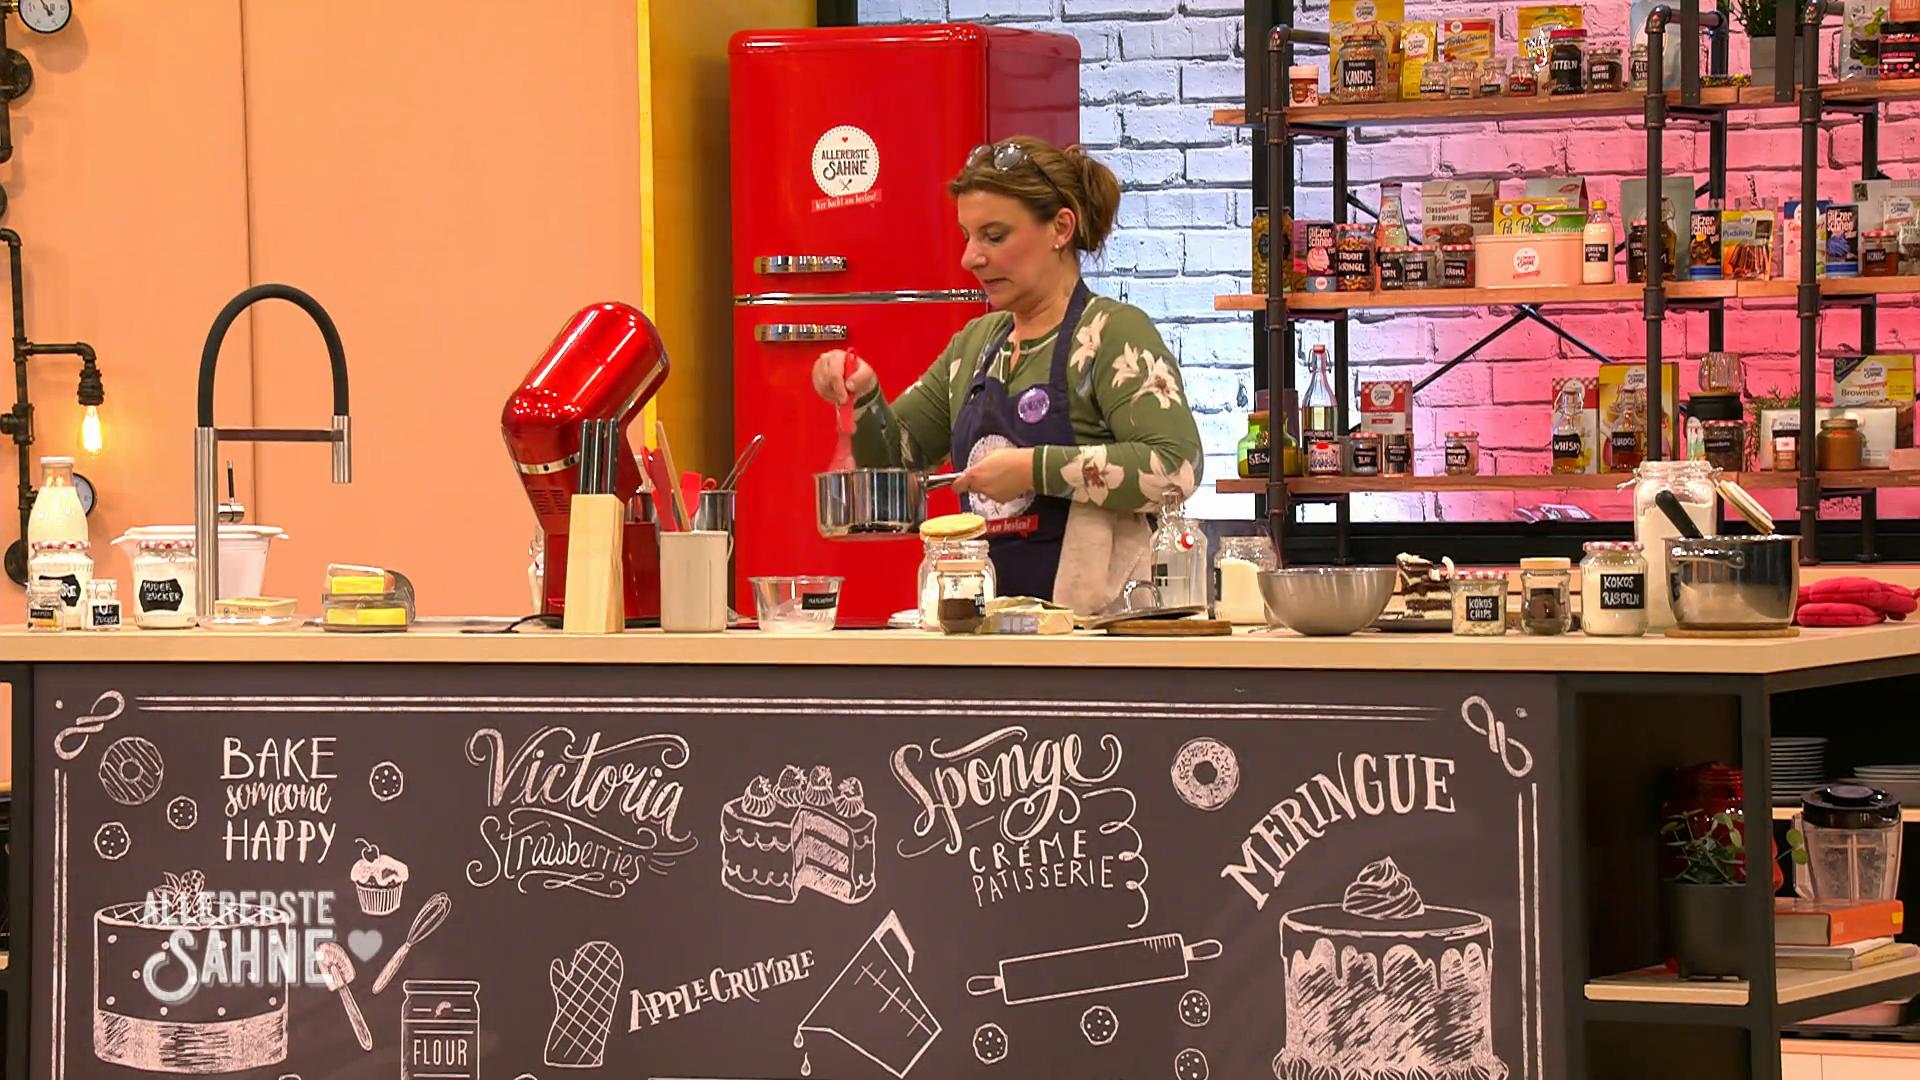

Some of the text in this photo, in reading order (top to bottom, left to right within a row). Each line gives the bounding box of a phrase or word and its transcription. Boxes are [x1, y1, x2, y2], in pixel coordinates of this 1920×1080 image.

[1345, 70, 1373, 85] KANDIS
[821, 149, 870, 160] ALLERERSTE
[822, 160, 868, 180] SAHNE
[1723, 229, 1753, 240] Pudding
[1841, 389, 1880, 397] Brownies
[1602, 575, 1635, 589] KOKOS
[145, 591, 181, 602] ZUCKER
[1468, 598, 1493, 610] KOKOS
[1601, 591, 1640, 606] RASPELN
[1469, 609, 1492, 620] CHIPS
[220, 736, 338, 784] BAKE
[466, 726, 692, 842] Victoria
[889, 725, 1123, 856] Sponge
[224, 778, 332, 818] someone
[1220, 751, 1456, 911] MERINGUE
[221, 819, 337, 864] HAPPY
[466, 815, 648, 890] Strawberries
[972, 855, 1114, 907] PATISSERIE
[412, 1038, 468, 1067] FLOUR
